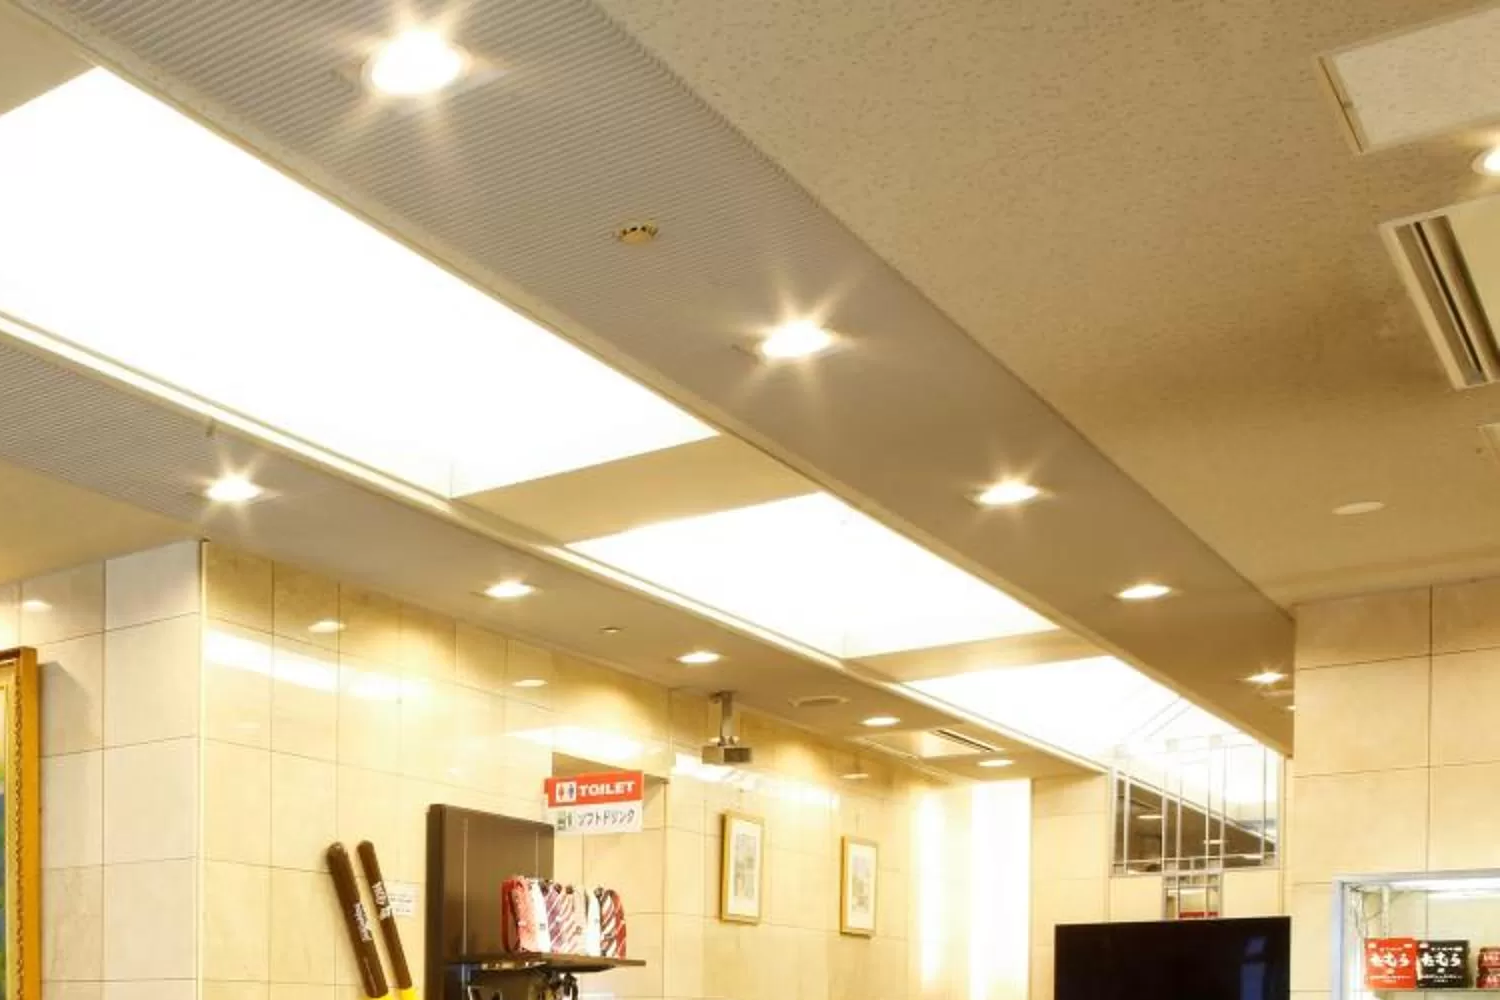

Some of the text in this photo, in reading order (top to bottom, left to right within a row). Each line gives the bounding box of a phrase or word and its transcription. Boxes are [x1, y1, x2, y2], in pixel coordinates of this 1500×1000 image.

[579, 781, 634, 797] TOILET
[578, 808, 635, 826] ソフトドリンク
